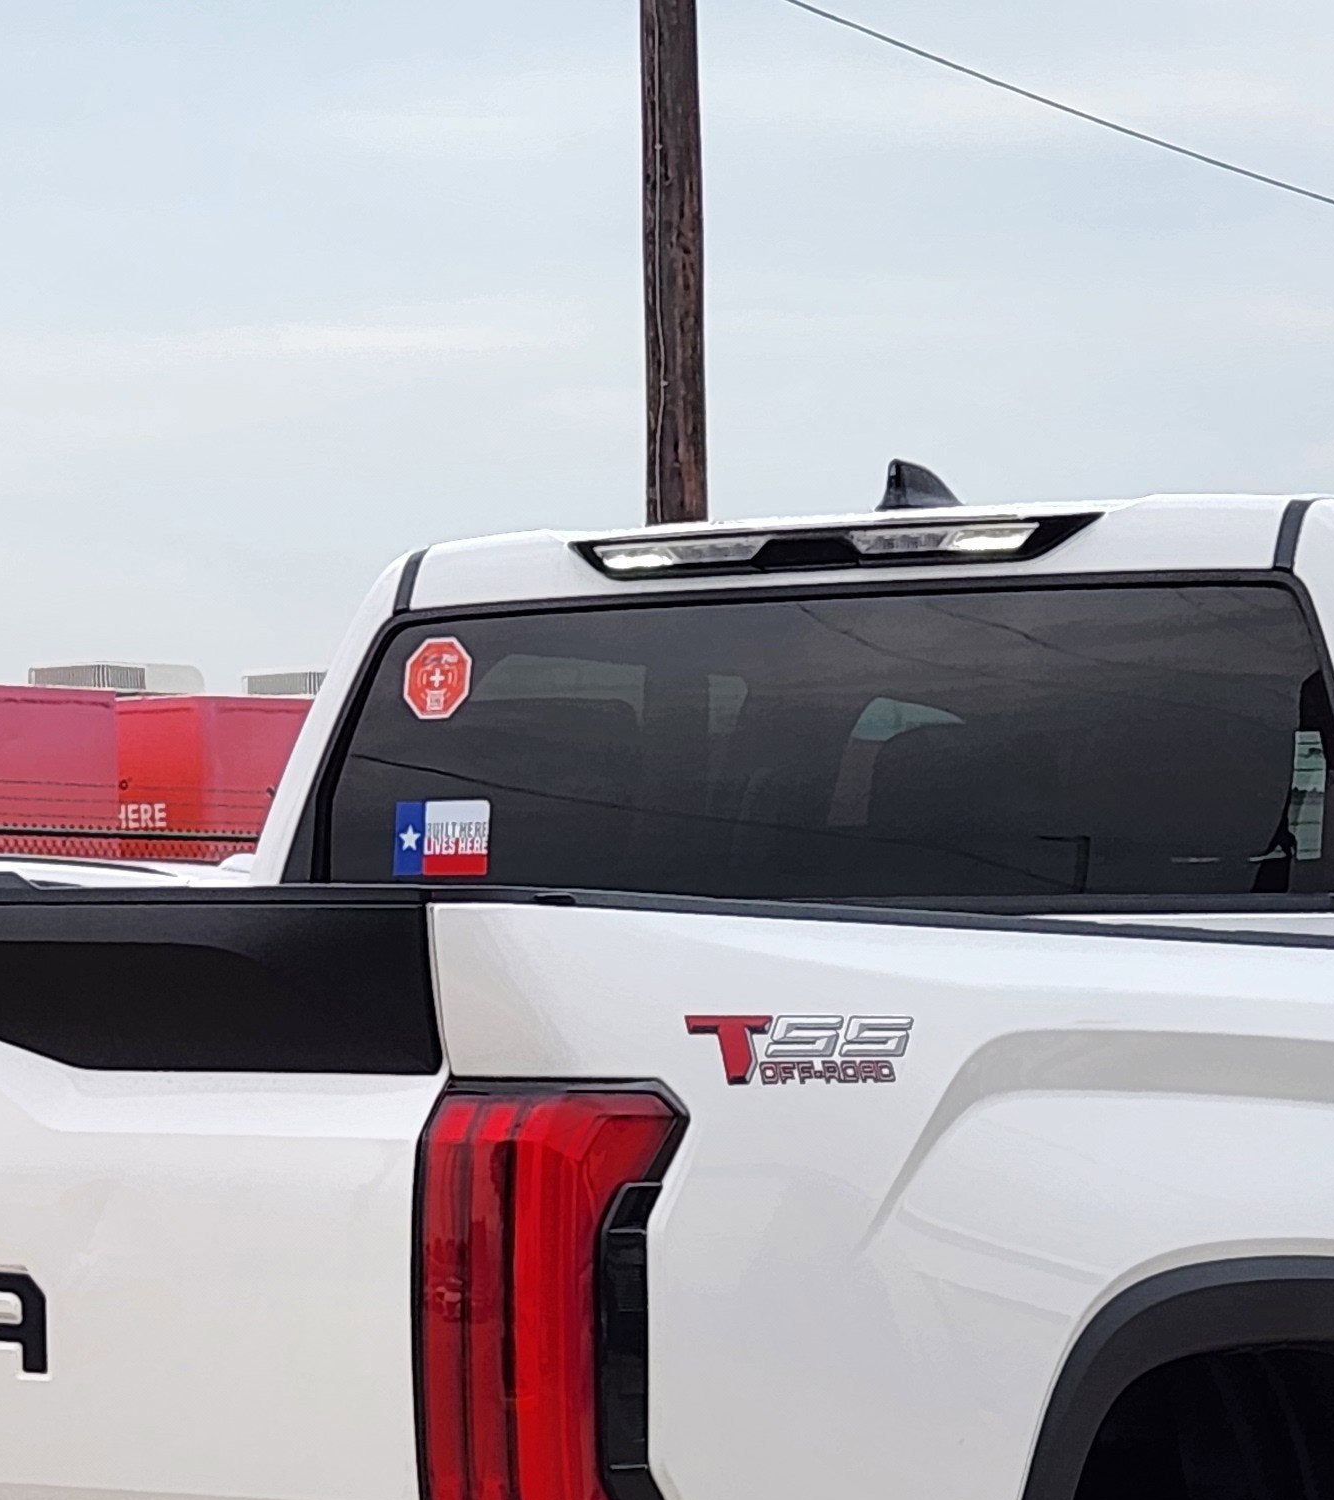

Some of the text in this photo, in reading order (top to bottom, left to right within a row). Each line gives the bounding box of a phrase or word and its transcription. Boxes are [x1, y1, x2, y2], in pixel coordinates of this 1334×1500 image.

[426, 821, 488, 838] BUILT HERE
[424, 837, 488, 855] LIVES HERE
[759, 1060, 897, 1084] OFF-ROAD
